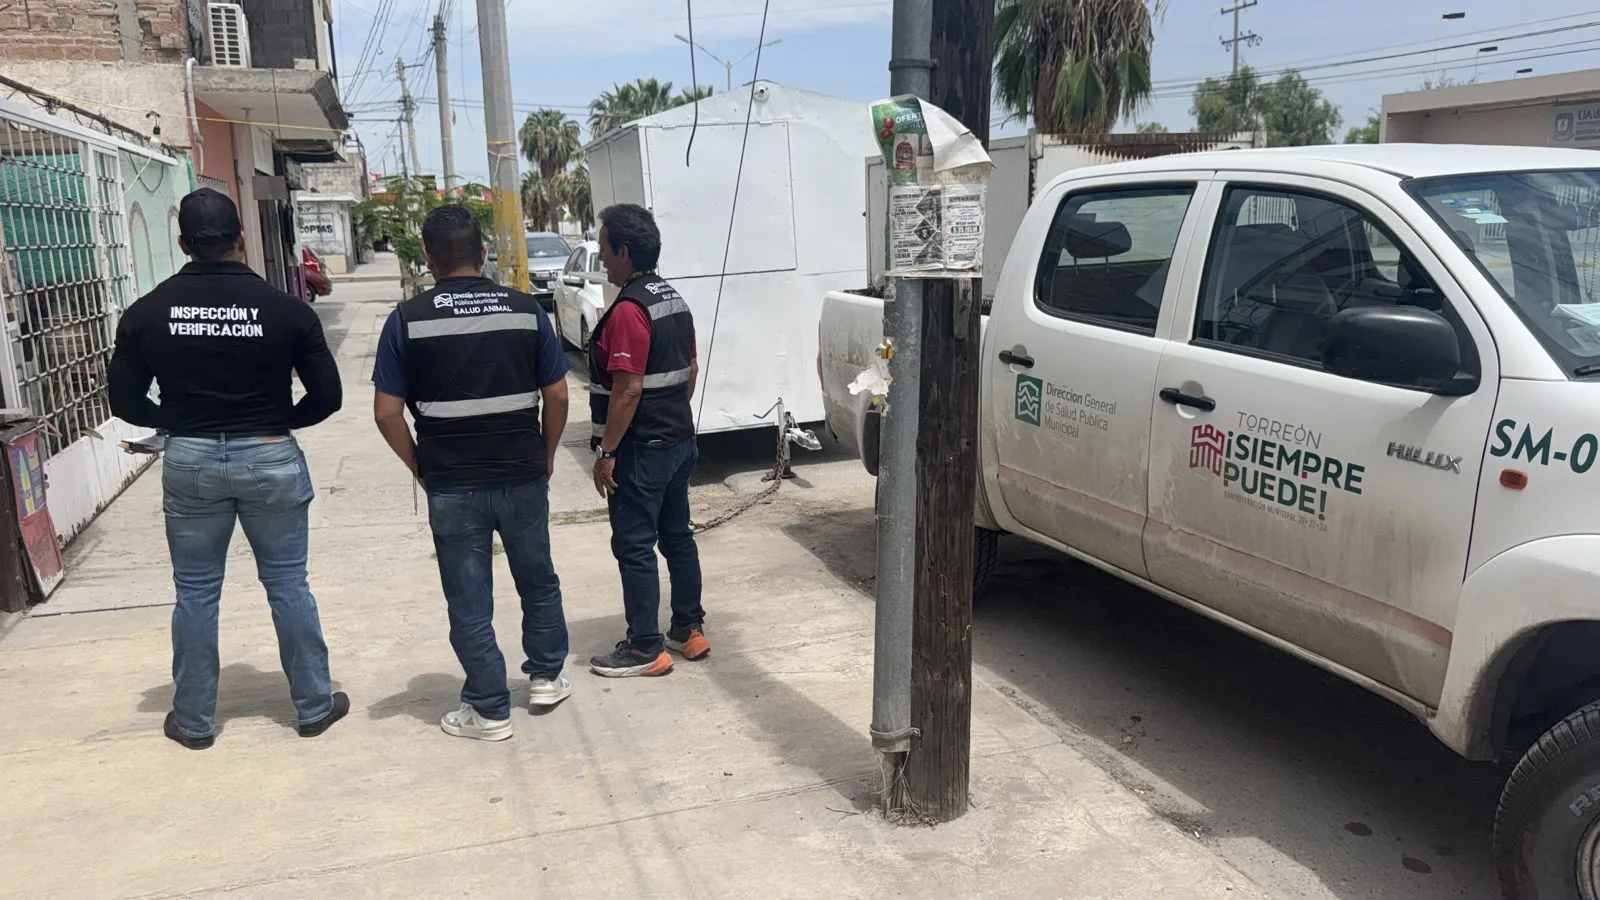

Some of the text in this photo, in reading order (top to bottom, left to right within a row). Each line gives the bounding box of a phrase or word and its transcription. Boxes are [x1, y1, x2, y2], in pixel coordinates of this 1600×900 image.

[170, 304, 259, 321] INSPECCIÓN Y
[453, 305, 512, 315] SALUD ANIMAL
[168, 320, 264, 337] VERIFICACIÓN
[1044, 401, 1055, 413] de
[1056, 402, 1077, 421] Salud
[1084, 393, 1117, 415] General
[1044, 415, 1079, 438] Municipal
[1237, 411, 1322, 450] TORREÓN
[1386, 441, 1463, 474] HILUX
[1489, 418, 1599, 474] SM-0
[1225, 431, 1366, 495] ¡SIEMPRE
[1223, 461, 1328, 521] PUEDE!
